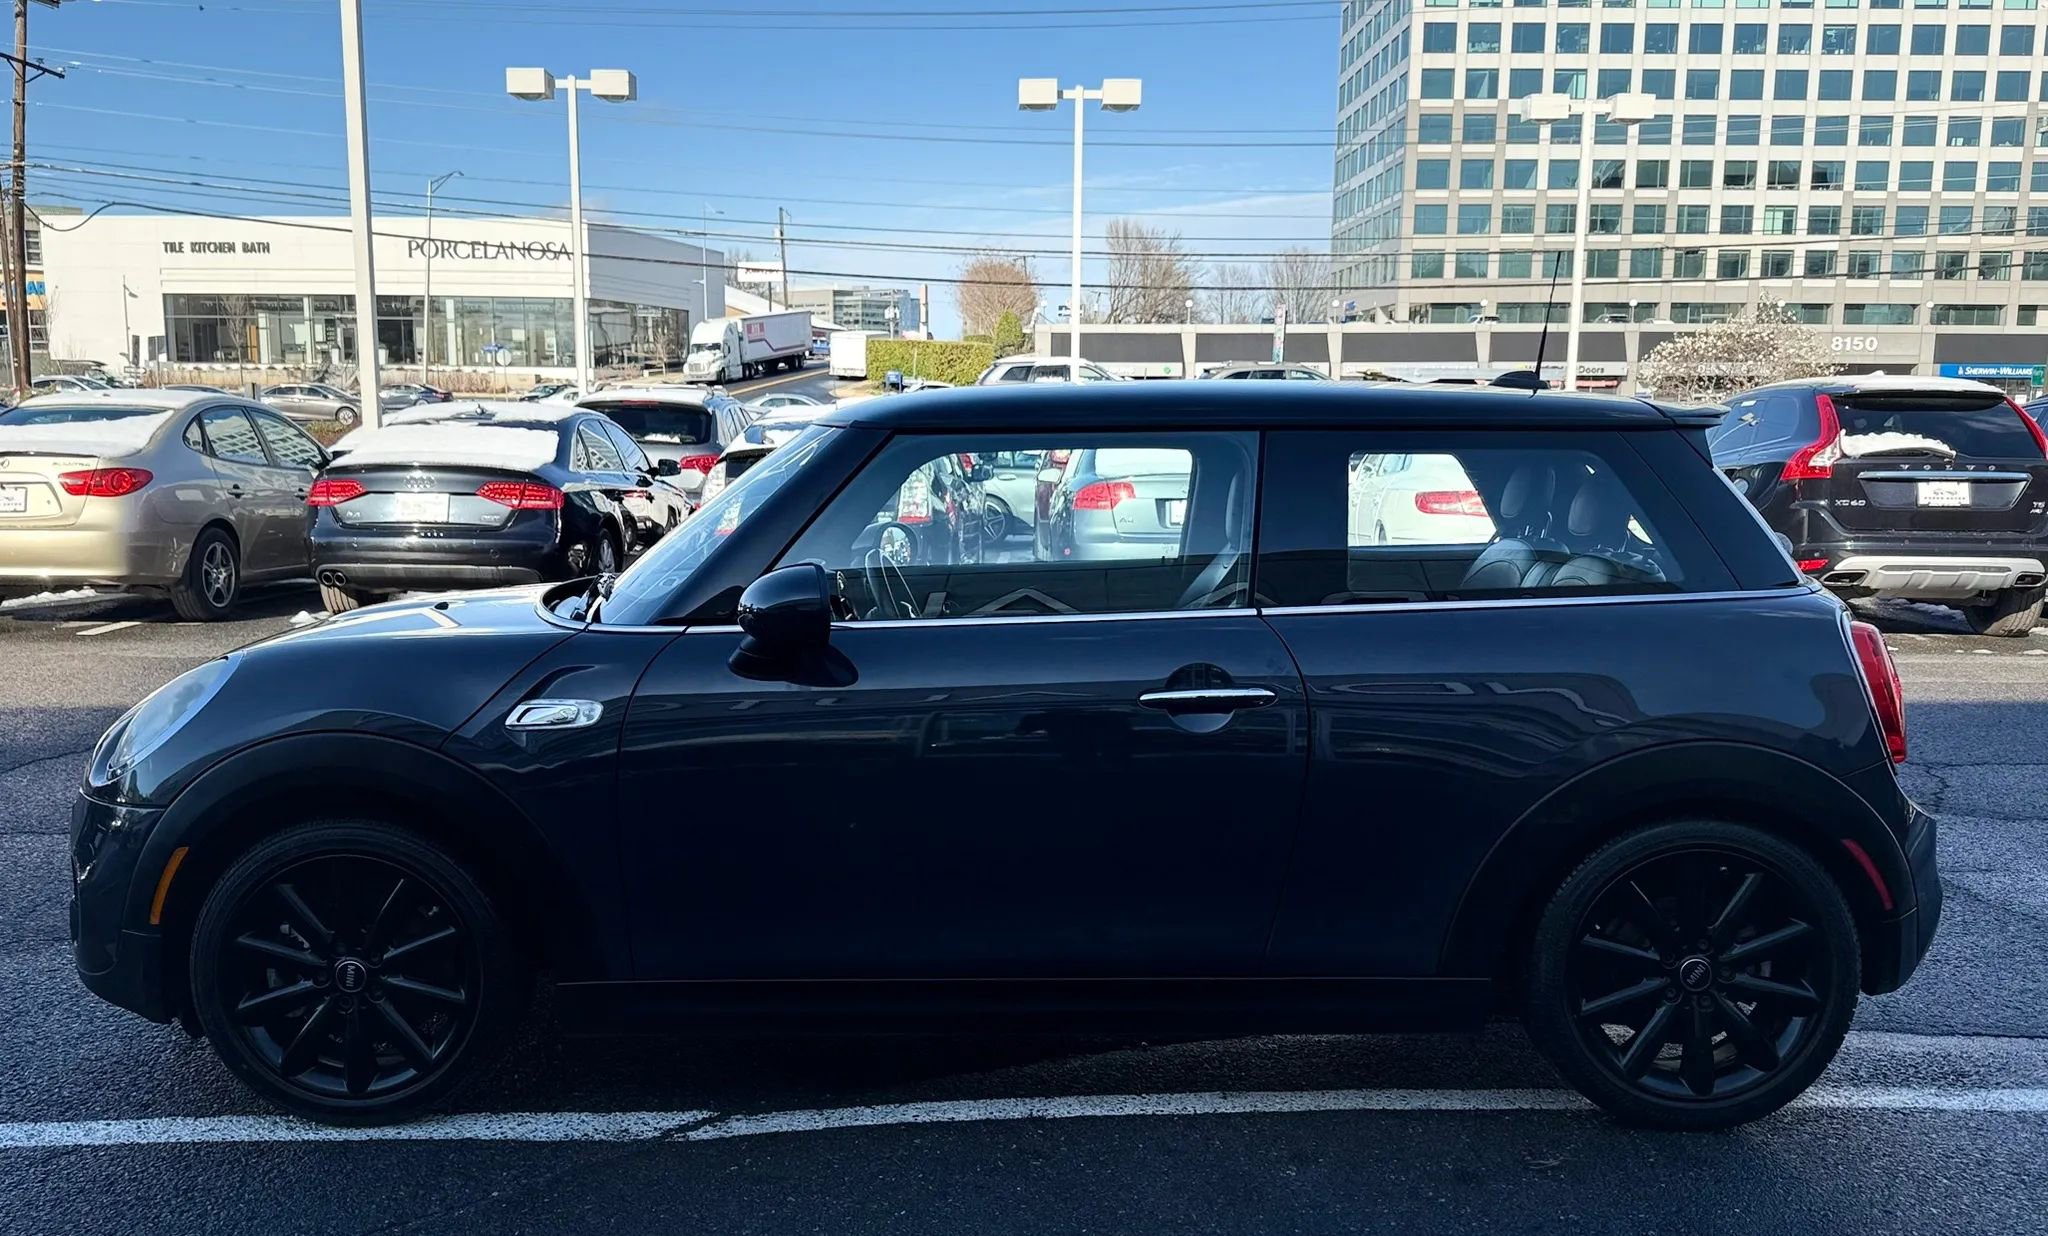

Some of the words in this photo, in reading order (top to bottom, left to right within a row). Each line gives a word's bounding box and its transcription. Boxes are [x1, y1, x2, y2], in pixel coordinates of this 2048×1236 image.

[162, 241, 184, 253] TILE
[190, 241, 235, 253] KITCHEN
[242, 241, 270, 254] BATH
[408, 239, 572, 260] PORCELANOSA
[1831, 336, 1878, 351] 8150
[345, 965, 356, 987] MINI
[1686, 964, 1706, 985] MINI
